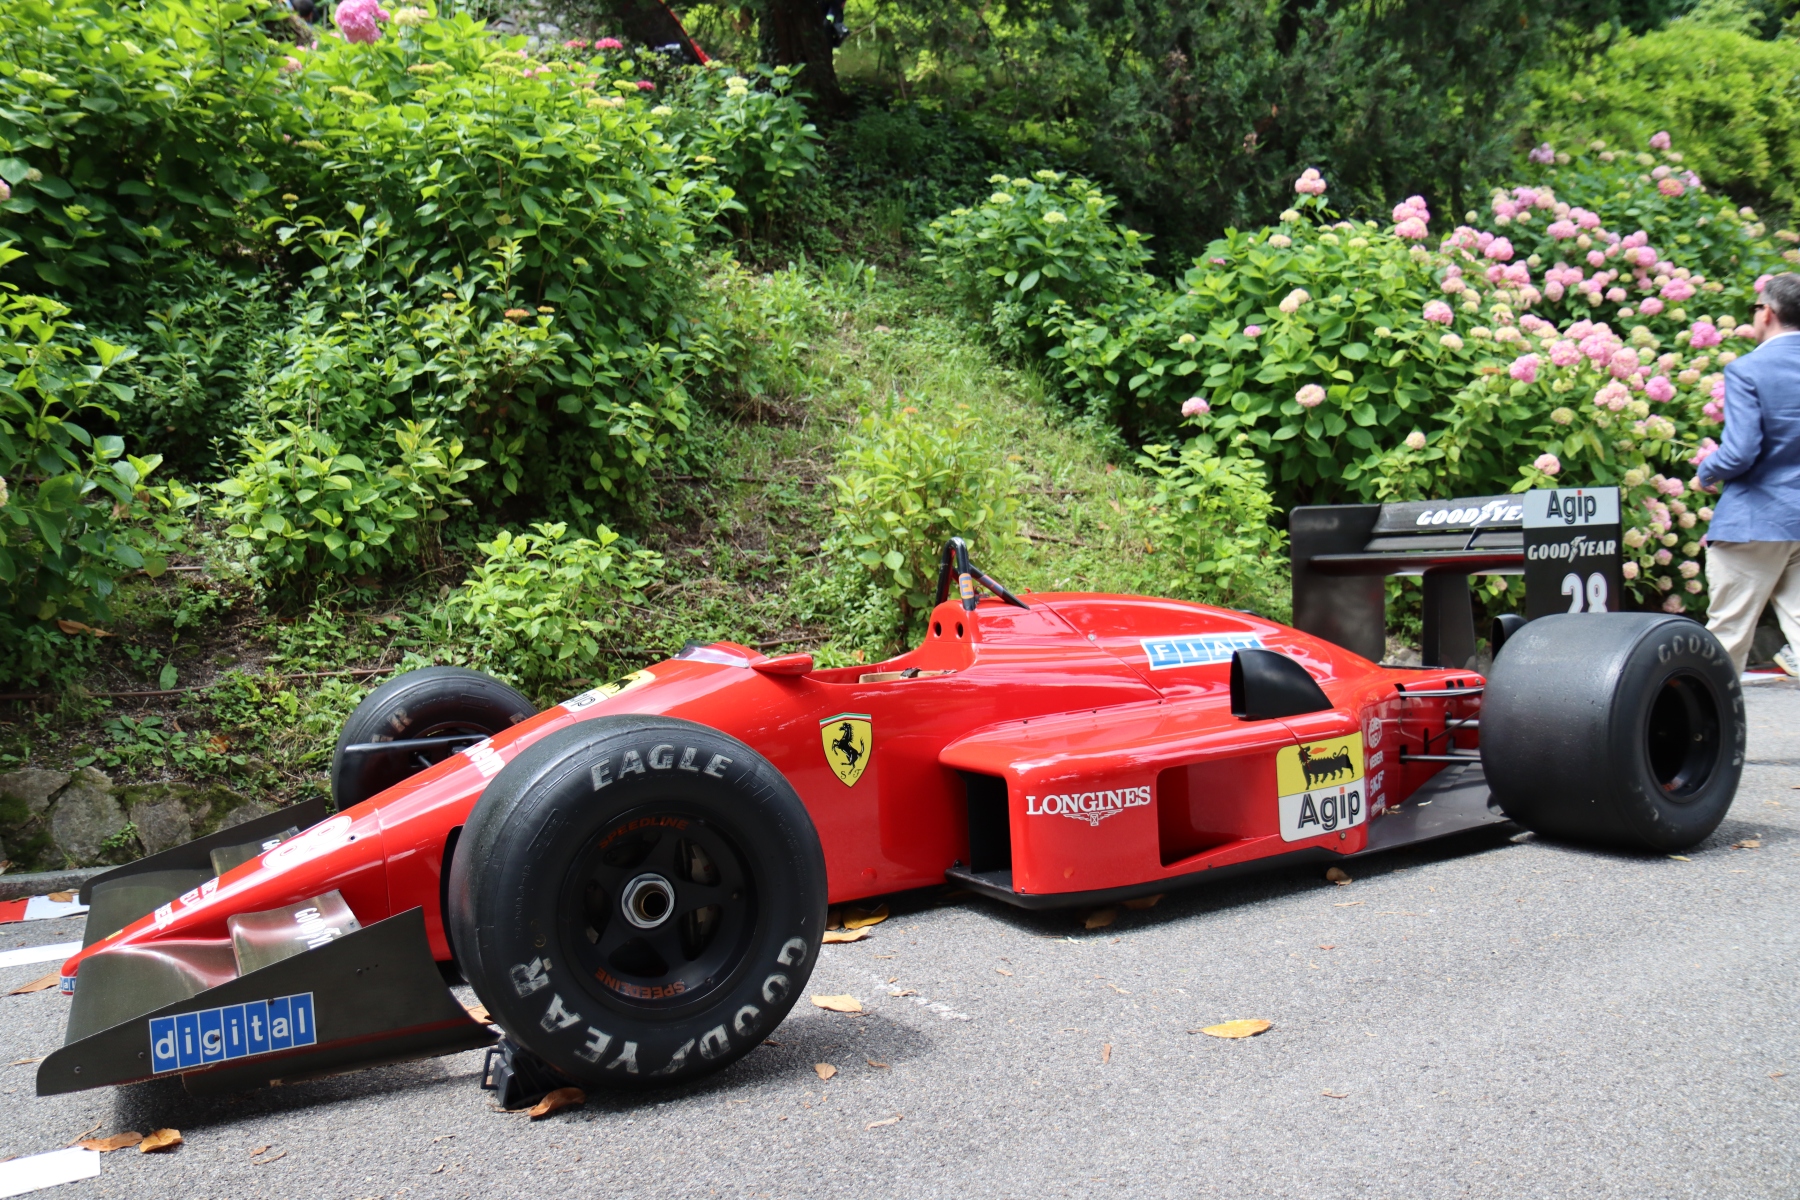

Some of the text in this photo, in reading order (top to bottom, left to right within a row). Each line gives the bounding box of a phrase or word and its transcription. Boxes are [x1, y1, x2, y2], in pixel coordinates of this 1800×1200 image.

[1416, 500, 1523, 527] GOODYE
[1546, 489, 1597, 525] Agip
[1527, 535, 1617, 563] GOODYEAR
[1561, 572, 1608, 613] 28
[1153, 638, 1253, 662] FIAT
[590, 744, 734, 791] EAGLE
[1026, 786, 1151, 816] LONGINES
[1297, 787, 1361, 832] Agip
[598, 816, 689, 849] SPEEDLINE
[594, 964, 686, 1000] SPEEDLINE
[155, 1007, 306, 1060] digital
